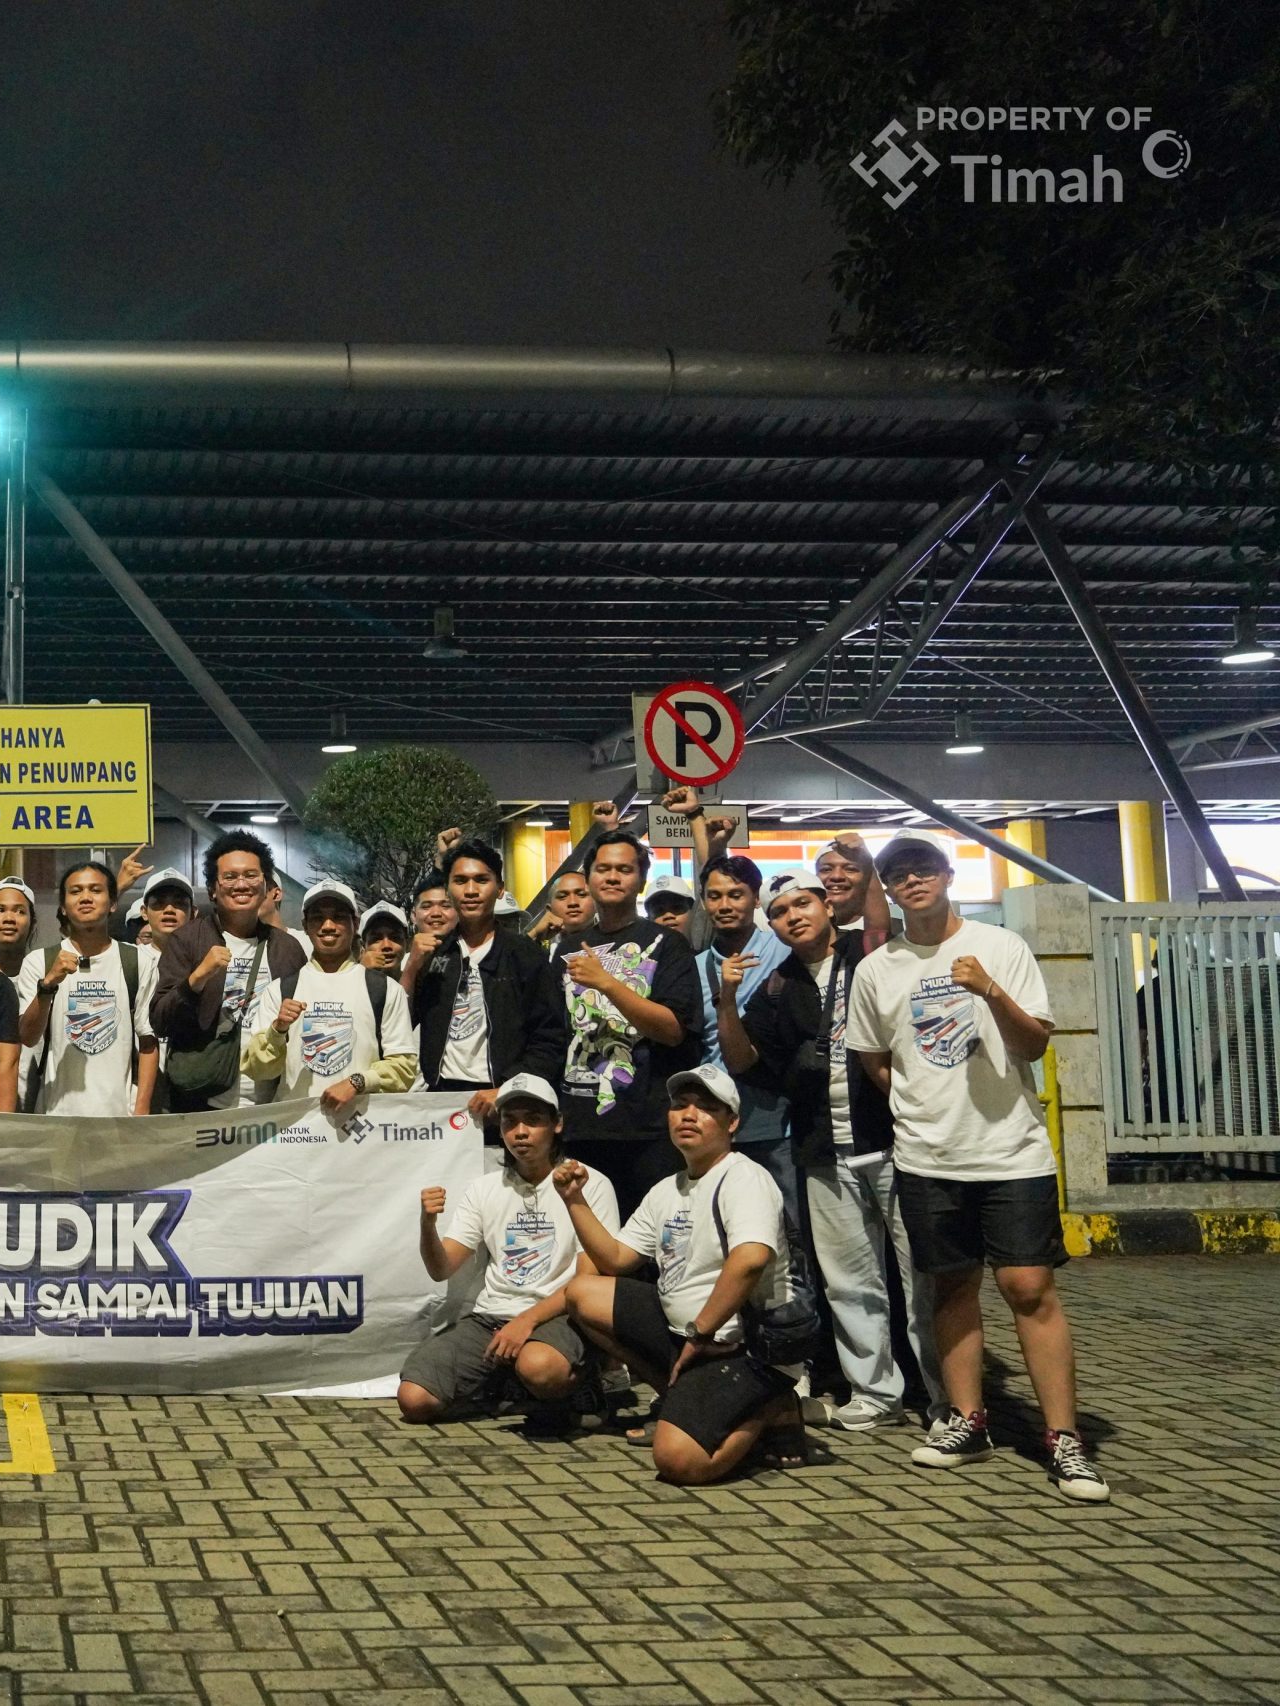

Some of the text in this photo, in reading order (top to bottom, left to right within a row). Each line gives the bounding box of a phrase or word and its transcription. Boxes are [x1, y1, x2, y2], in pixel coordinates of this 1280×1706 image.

[1, 728, 65, 748] HANYA
[19, 761, 137, 783] PENUMPANG
[12, 805, 94, 829] AREA
[78, 982, 106, 990] MUDIK
[314, 1002, 342, 1011] MUDIK
[280, 1126, 310, 1135] UNTUK
[280, 1135, 328, 1144] INDONESIA
[379, 1122, 443, 1142] Timah
[36, 1282, 187, 1321] SAMPAI
[199, 1281, 358, 1320] TUJUAN
